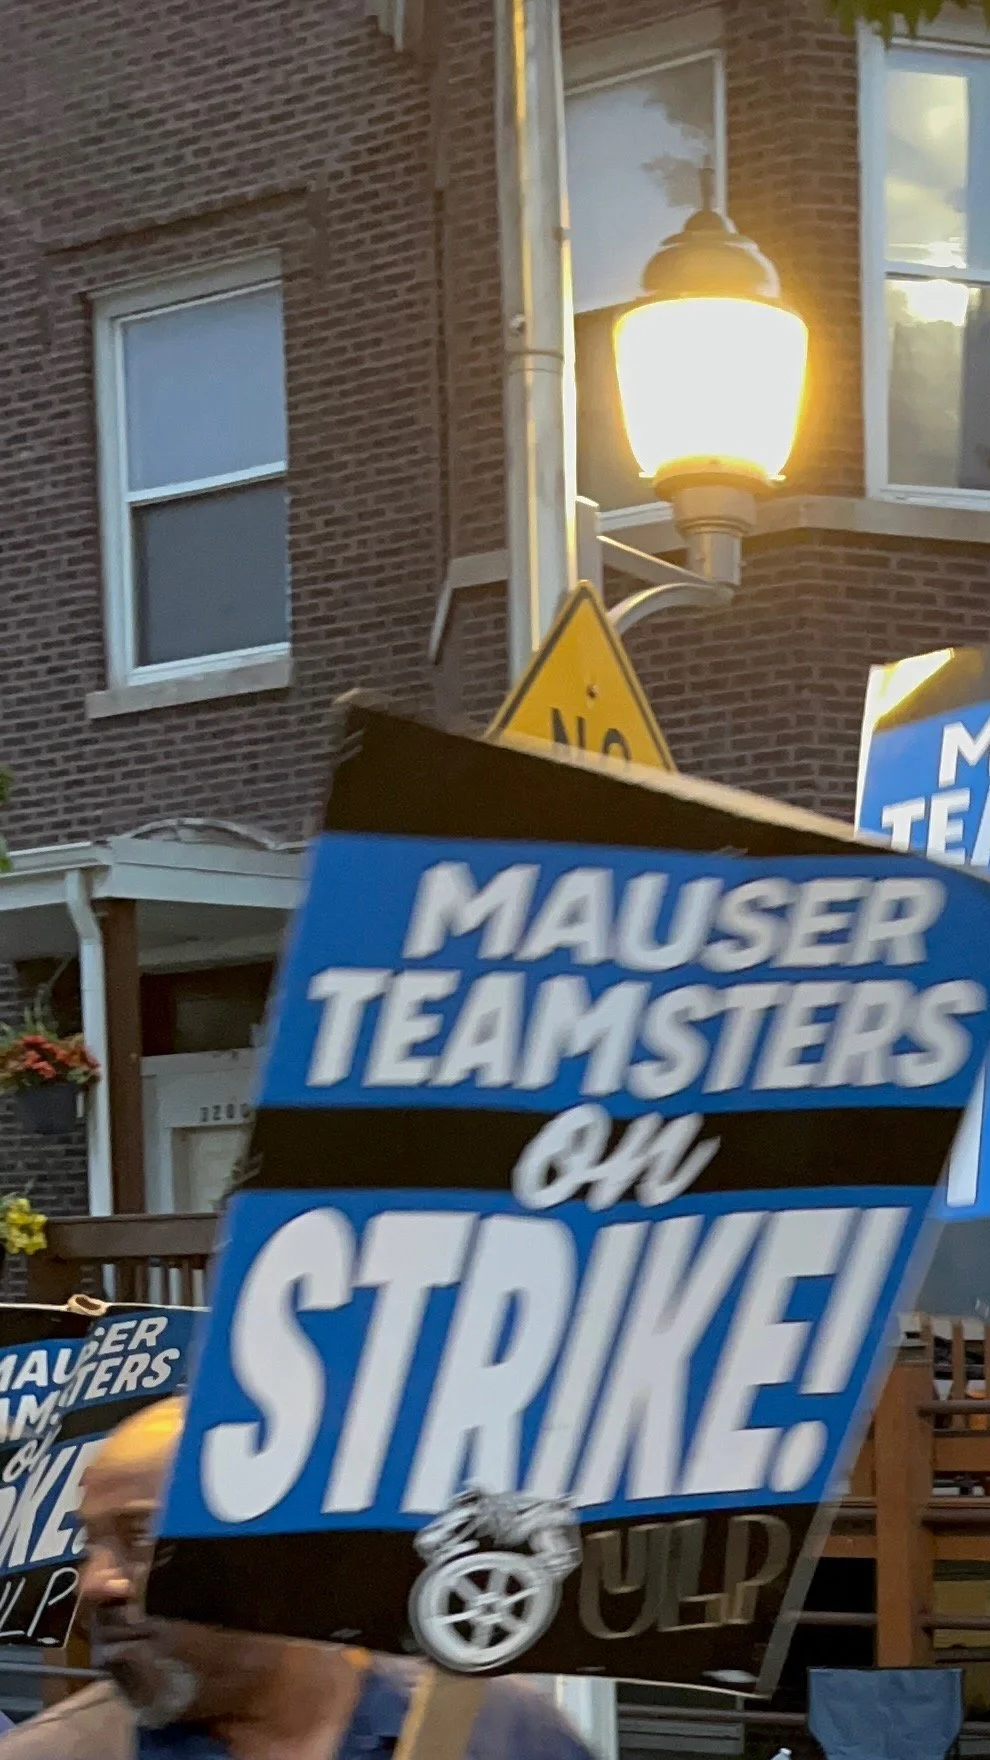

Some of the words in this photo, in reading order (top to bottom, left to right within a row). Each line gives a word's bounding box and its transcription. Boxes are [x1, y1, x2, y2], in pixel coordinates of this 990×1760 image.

[402, 862, 946, 973] MAUSER
[307, 968, 988, 1101] TEAMSTERS
[512, 1103, 720, 1211] on
[202, 1204, 911, 1525] STRIKE!
[577, 1513, 792, 1639] ULP
